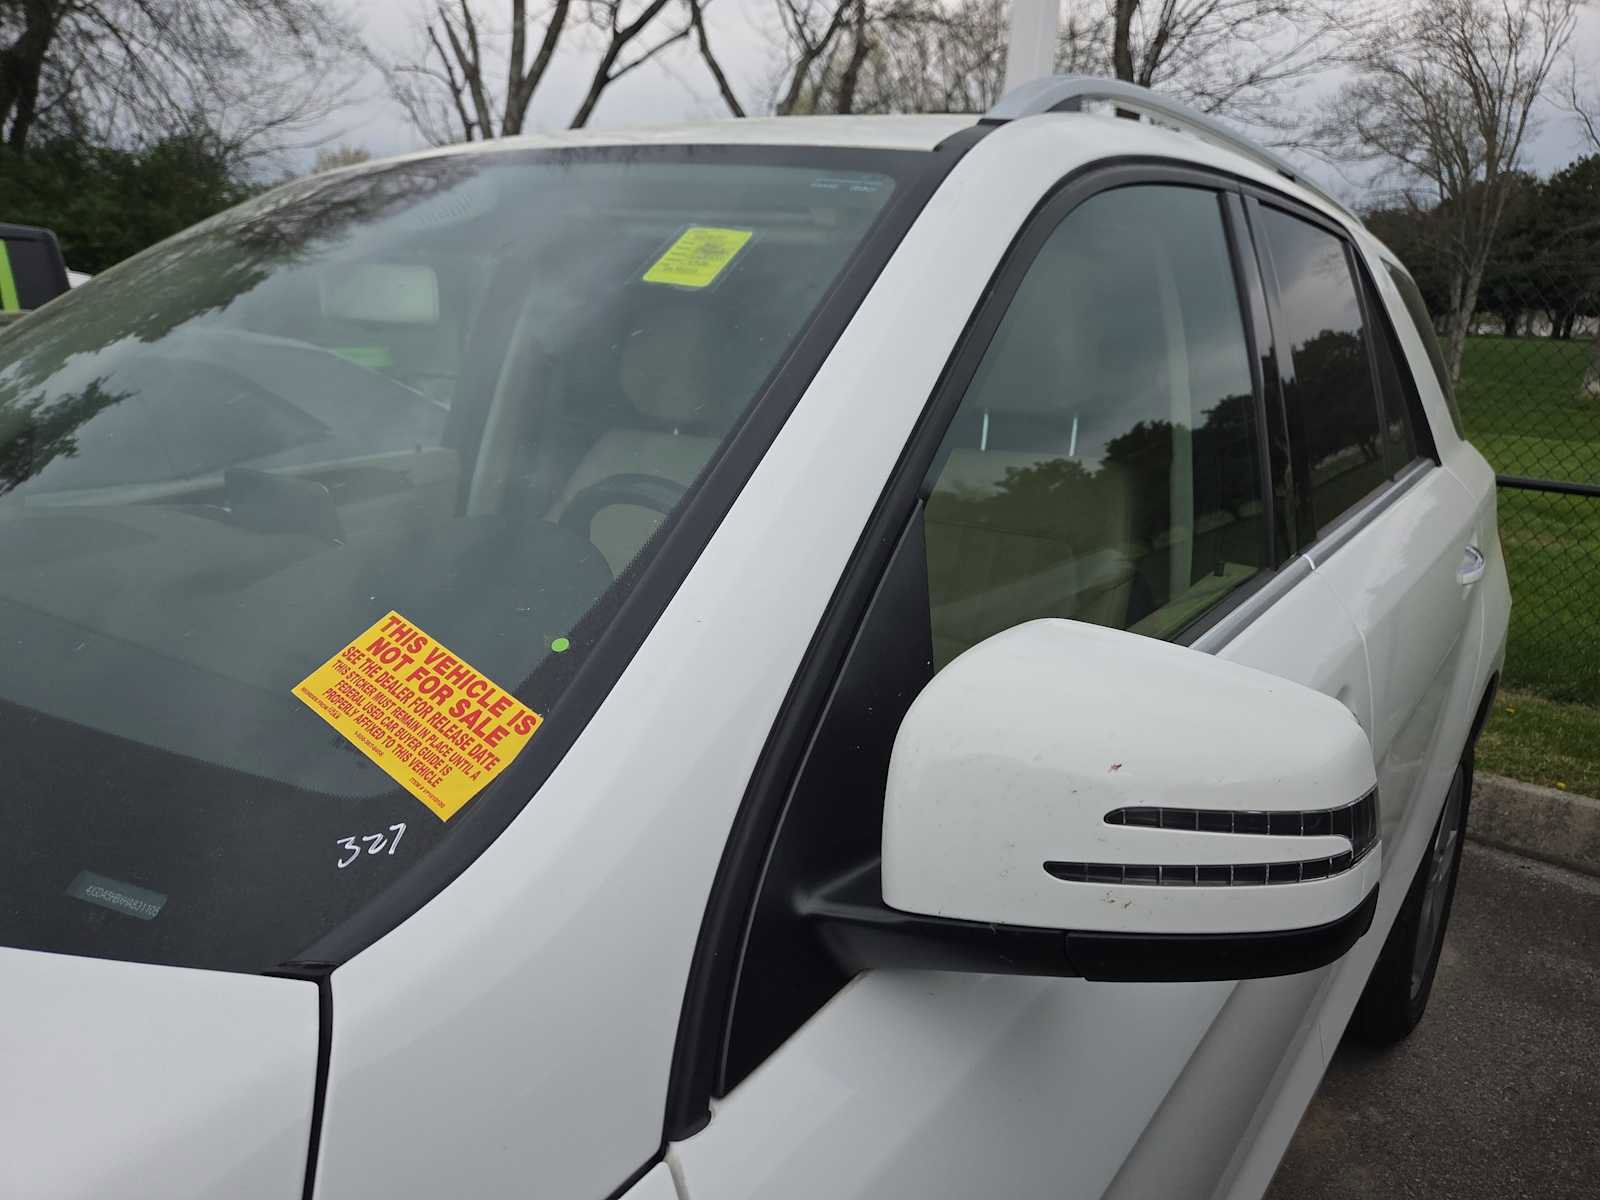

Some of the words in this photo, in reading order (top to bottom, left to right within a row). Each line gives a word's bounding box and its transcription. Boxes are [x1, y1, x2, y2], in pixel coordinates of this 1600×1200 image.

[332, 660, 351, 675] THIS
[346, 671, 377, 697] STICKER
[371, 692, 397, 710] MUST
[391, 706, 422, 732] REMAIN
[417, 727, 431, 739] IN
[425, 734, 453, 757] PLACE
[449, 752, 474, 775] UNTIL
[470, 771, 481, 781] A
[335, 680, 365, 706] FEDERAL
[362, 702, 385, 720] USED
[380, 716, 399, 732] CAR
[394, 727, 422, 752] BUYER
[418, 747, 445, 770] GUIDE
[440, 764, 452, 776] IS
[342, 646, 366, 665] SEE
[359, 658, 383, 678] THE
[375, 671, 415, 704] DEALER
[408, 697, 434, 719] FOR
[427, 712, 475, 751] RELEASE
[467, 743, 500, 772] DATE
[366, 637, 415, 672] NOT
[405, 666, 454, 706] FOR
[448, 698, 510, 748] SALE
[381, 616, 428, 653] THIS
[424, 647, 514, 718] VEHICLE
[507, 709, 536, 736] IS
[322, 688, 360, 717] PROPERLY
[353, 714, 385, 740] AFFIXED
[381, 735, 396, 748] TO
[392, 743, 413, 762] THIS
[408, 757, 443, 788] VEHICLE
[337, 823, 406, 868] 327
